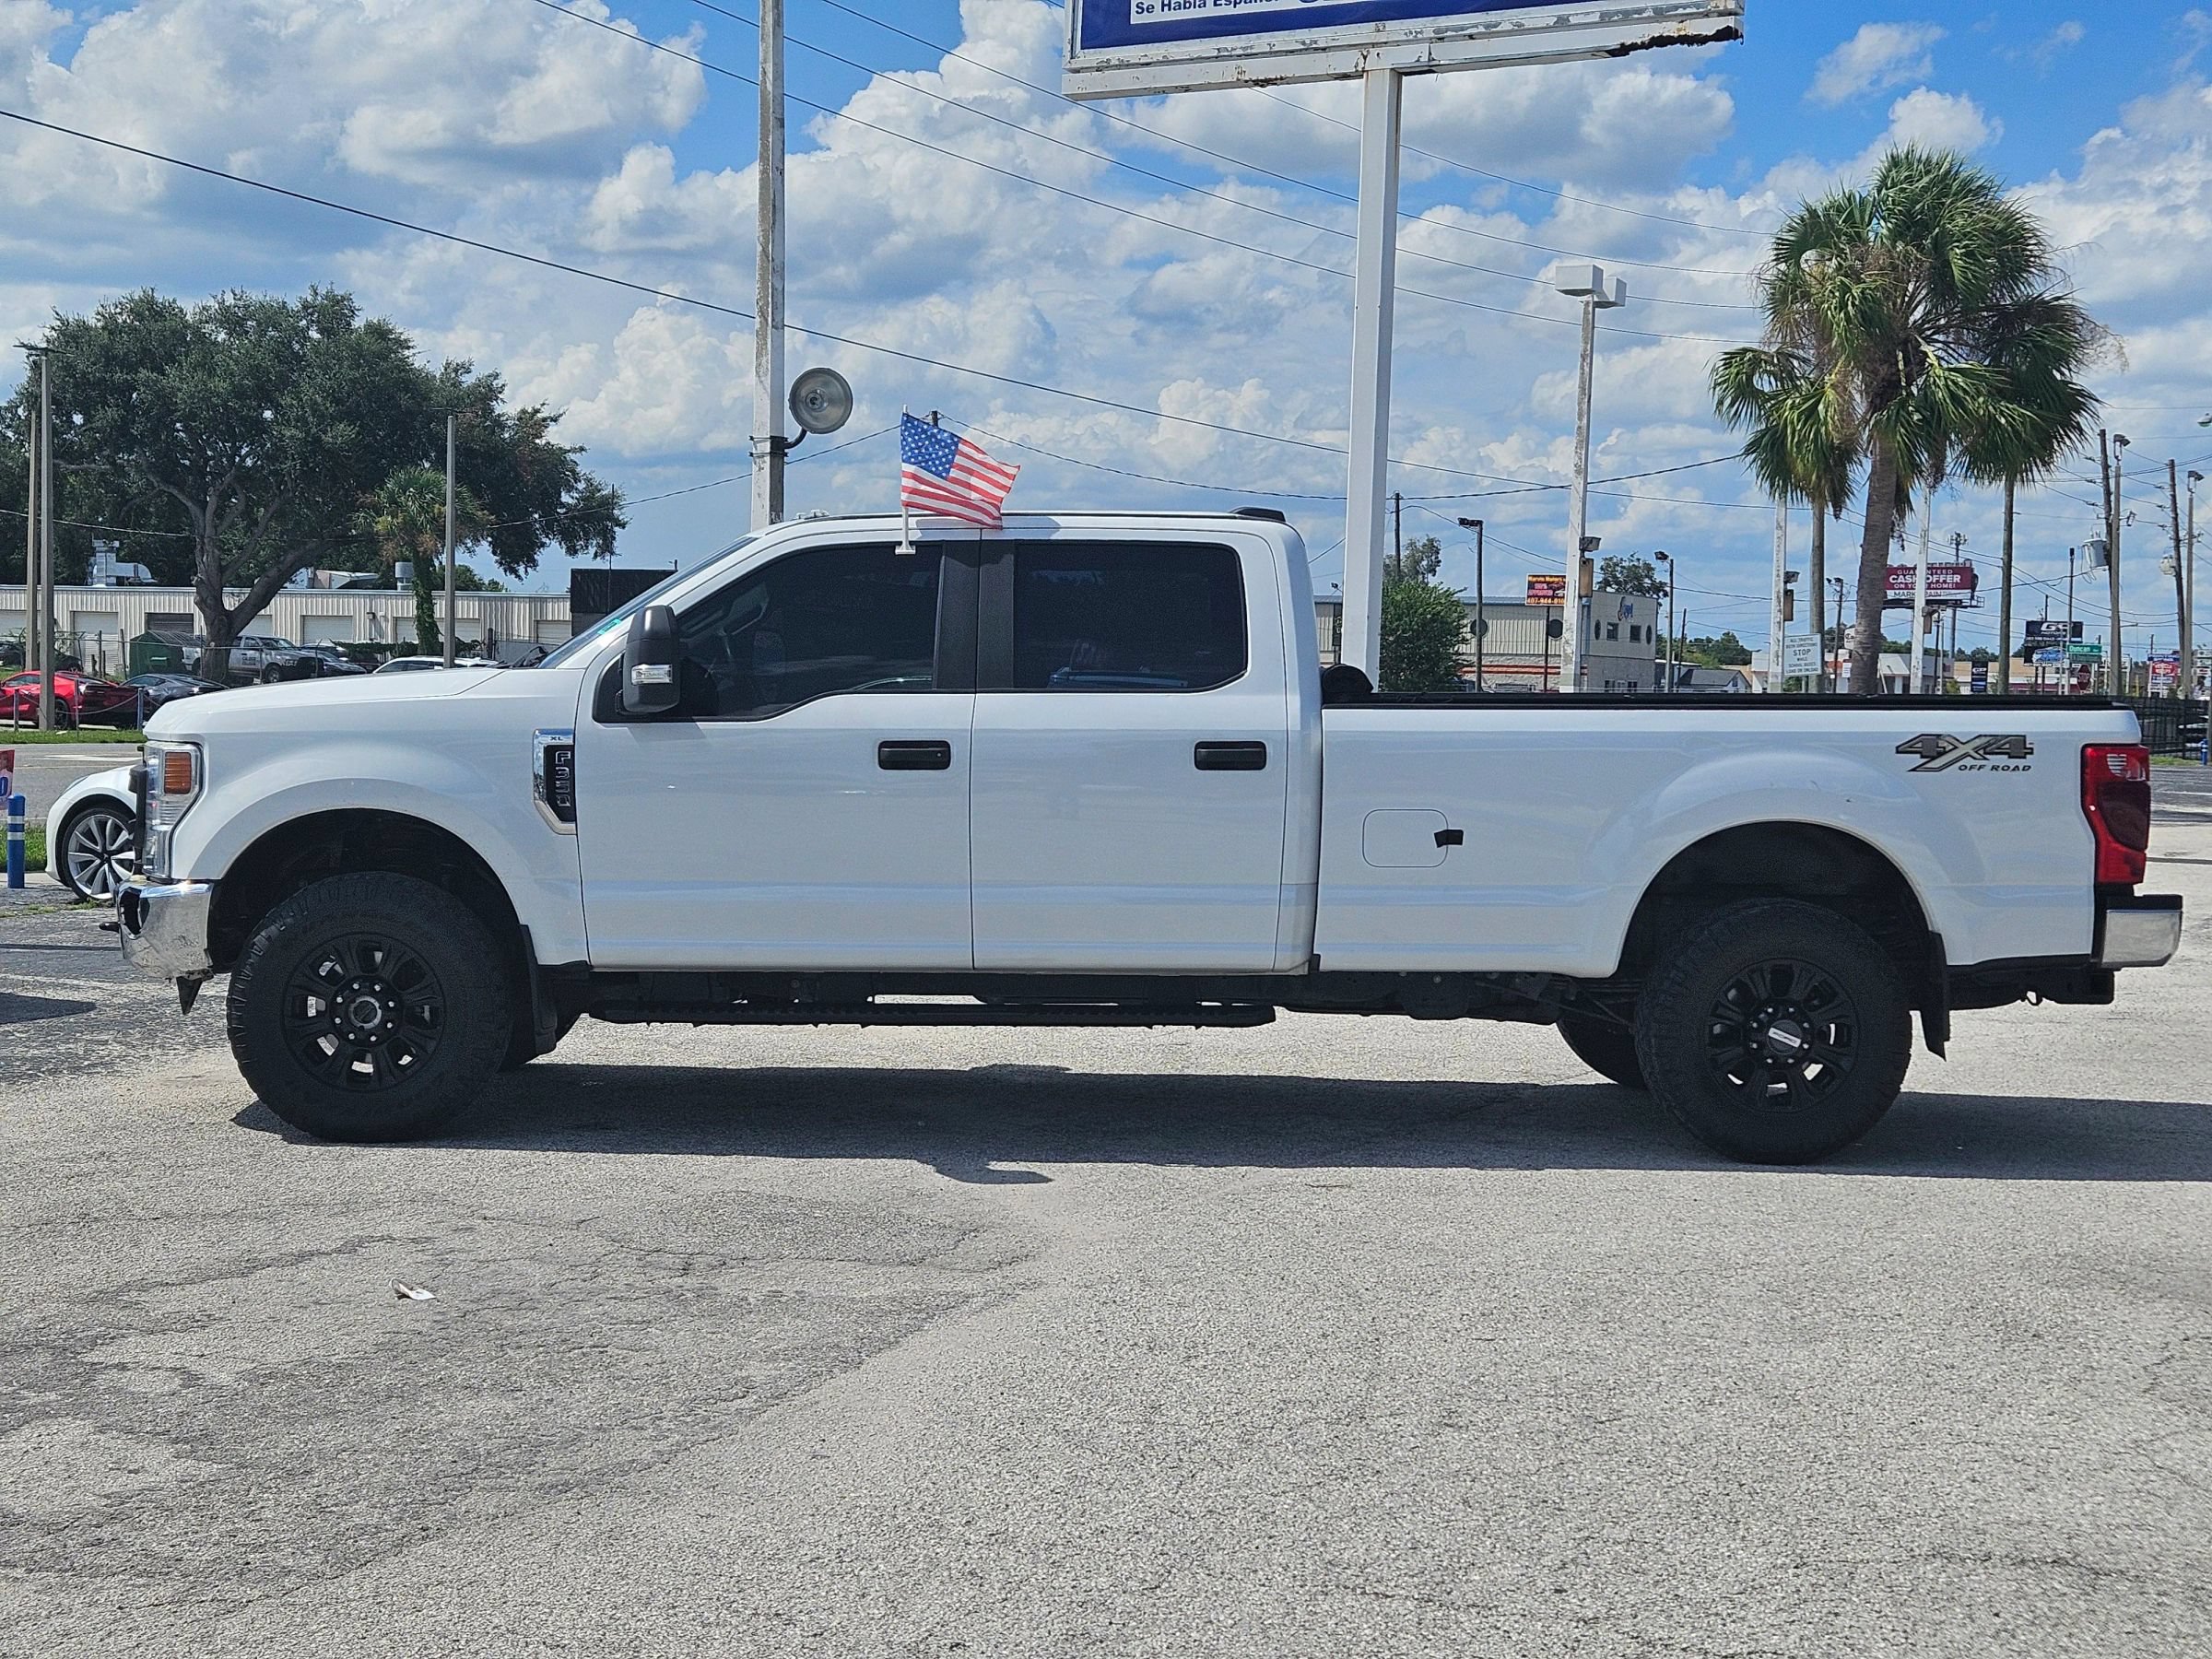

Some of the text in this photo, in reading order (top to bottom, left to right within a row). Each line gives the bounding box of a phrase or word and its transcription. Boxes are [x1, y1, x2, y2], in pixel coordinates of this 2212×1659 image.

[1135, 0, 1278, 15] Se Habla Espa
[1889, 574, 1961, 583] CASH OFFER
[1793, 648, 1811, 656] STOP
